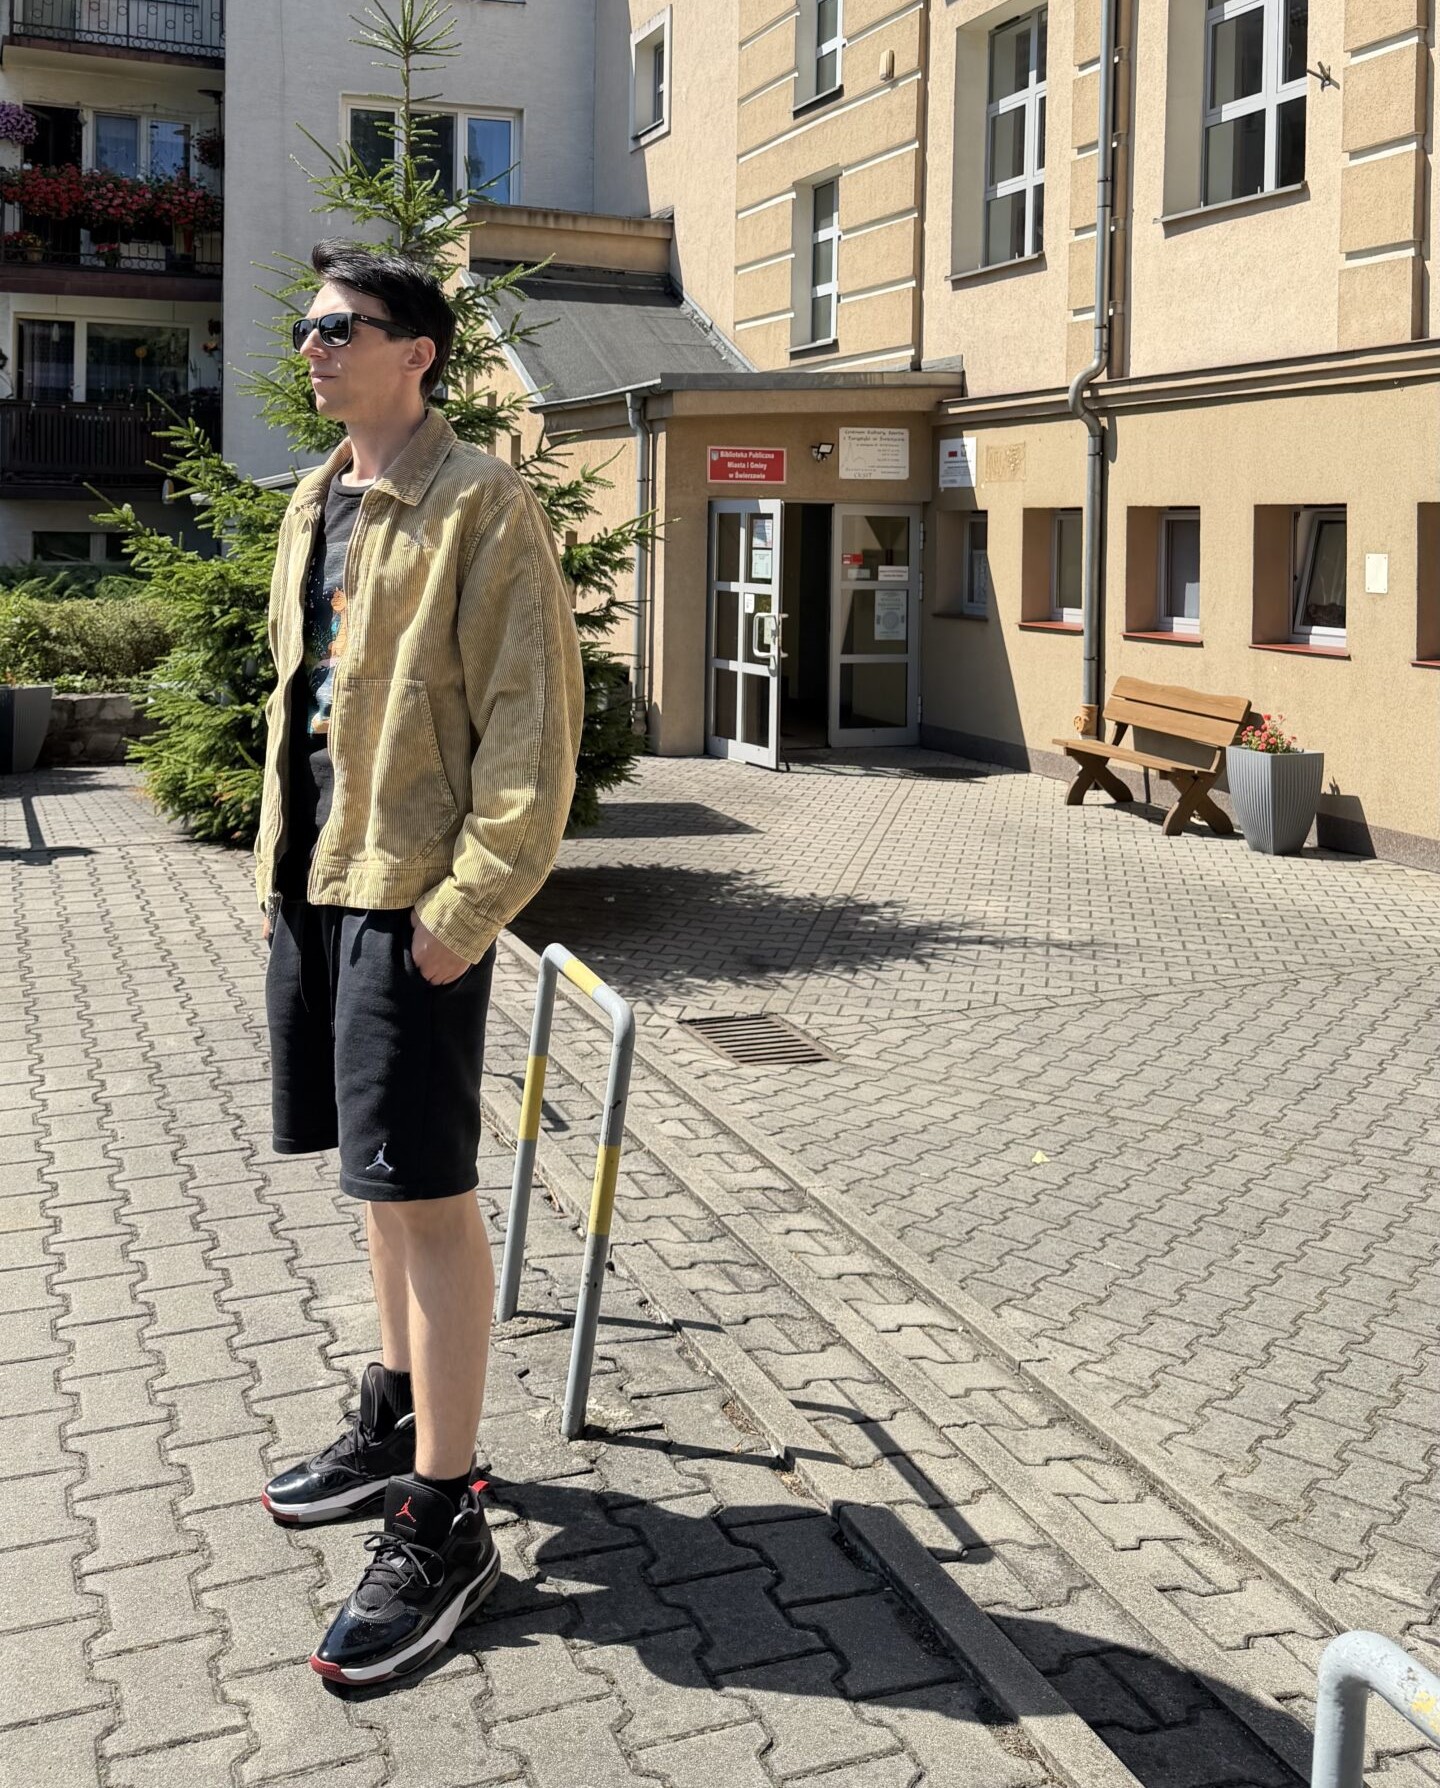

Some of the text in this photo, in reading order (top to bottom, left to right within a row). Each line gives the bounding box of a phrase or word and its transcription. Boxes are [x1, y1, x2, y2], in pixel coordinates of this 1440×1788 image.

[720, 450, 775, 459] Biblioteka Publiczna
[750, 462, 767, 471] Gminy
[735, 470, 766, 479] Świerzawie
